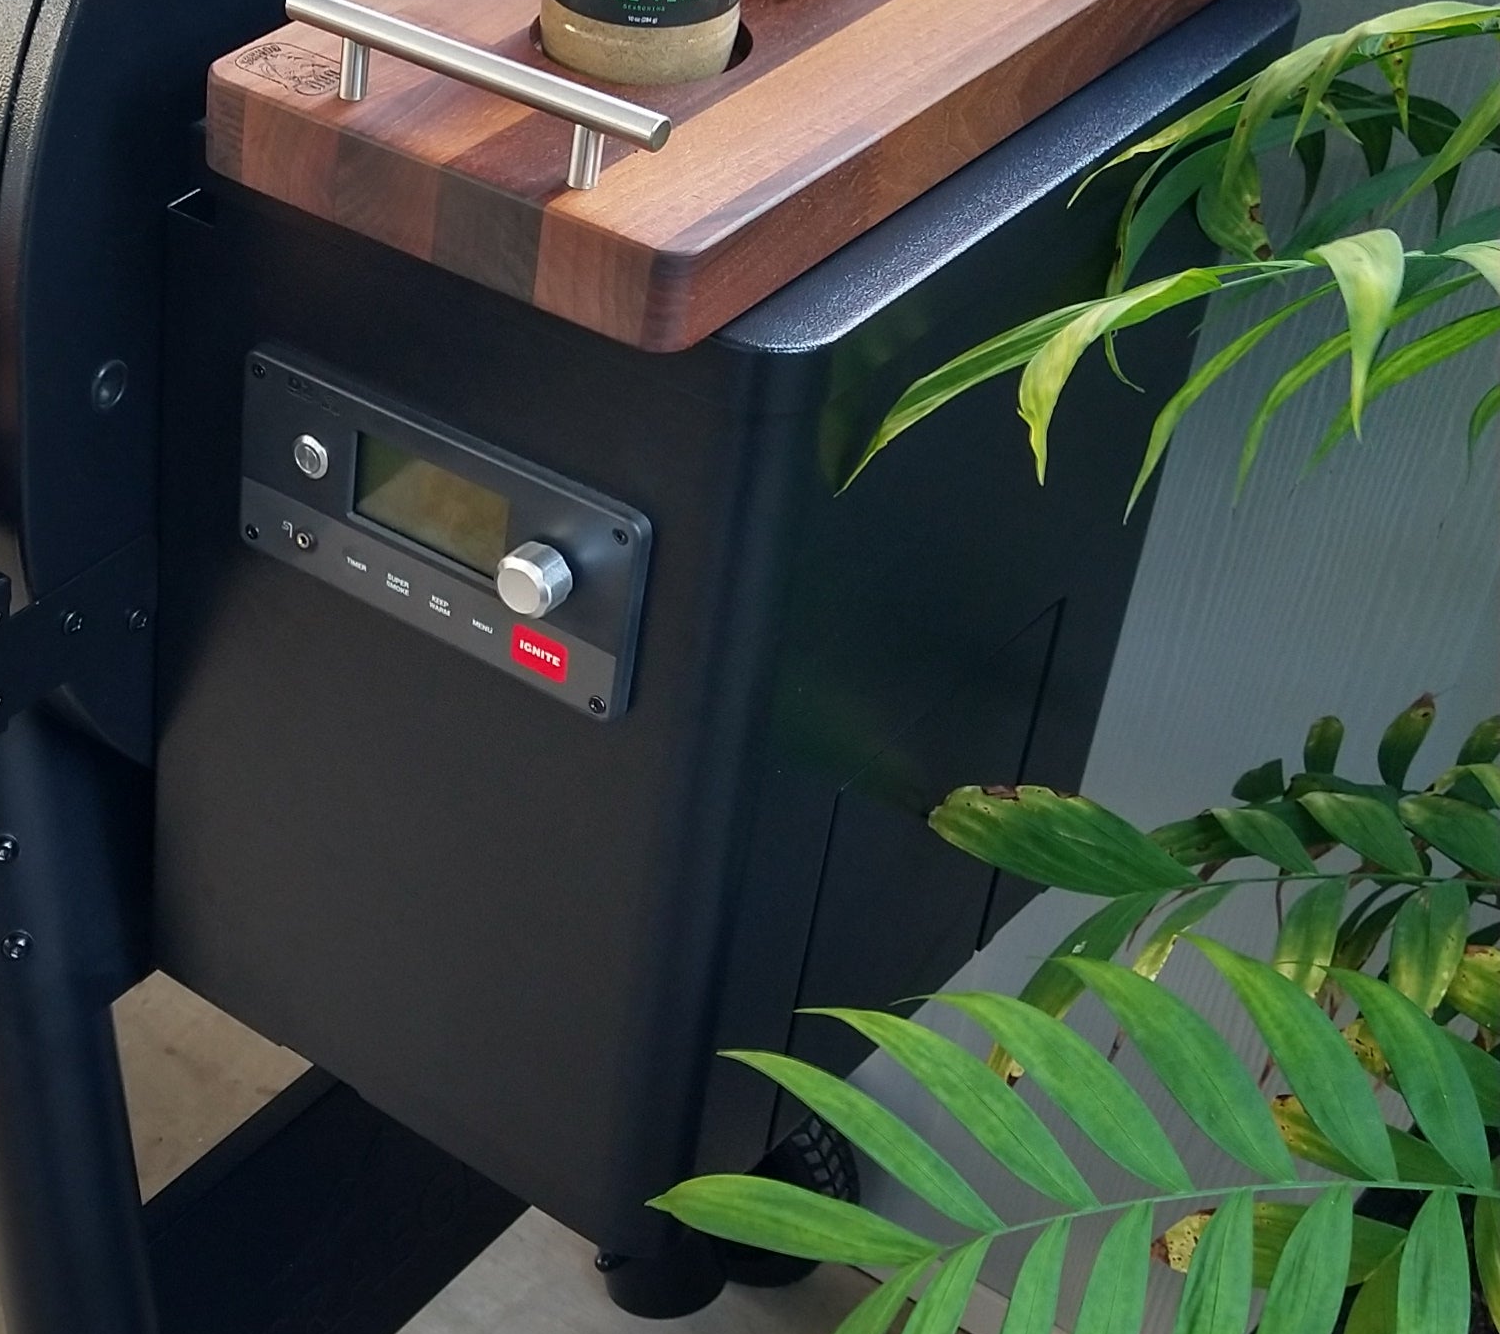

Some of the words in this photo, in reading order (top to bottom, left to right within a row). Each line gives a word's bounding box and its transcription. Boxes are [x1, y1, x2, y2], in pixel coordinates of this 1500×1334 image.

[346, 555, 367, 572] TIMER
[386, 580, 410, 597] SMOKE
[387, 572, 410, 589] SUPER
[429, 601, 451, 617] WARM
[431, 594, 449, 608] KEEP
[472, 618, 493, 635] MENU
[519, 639, 561, 668] IGNITE
